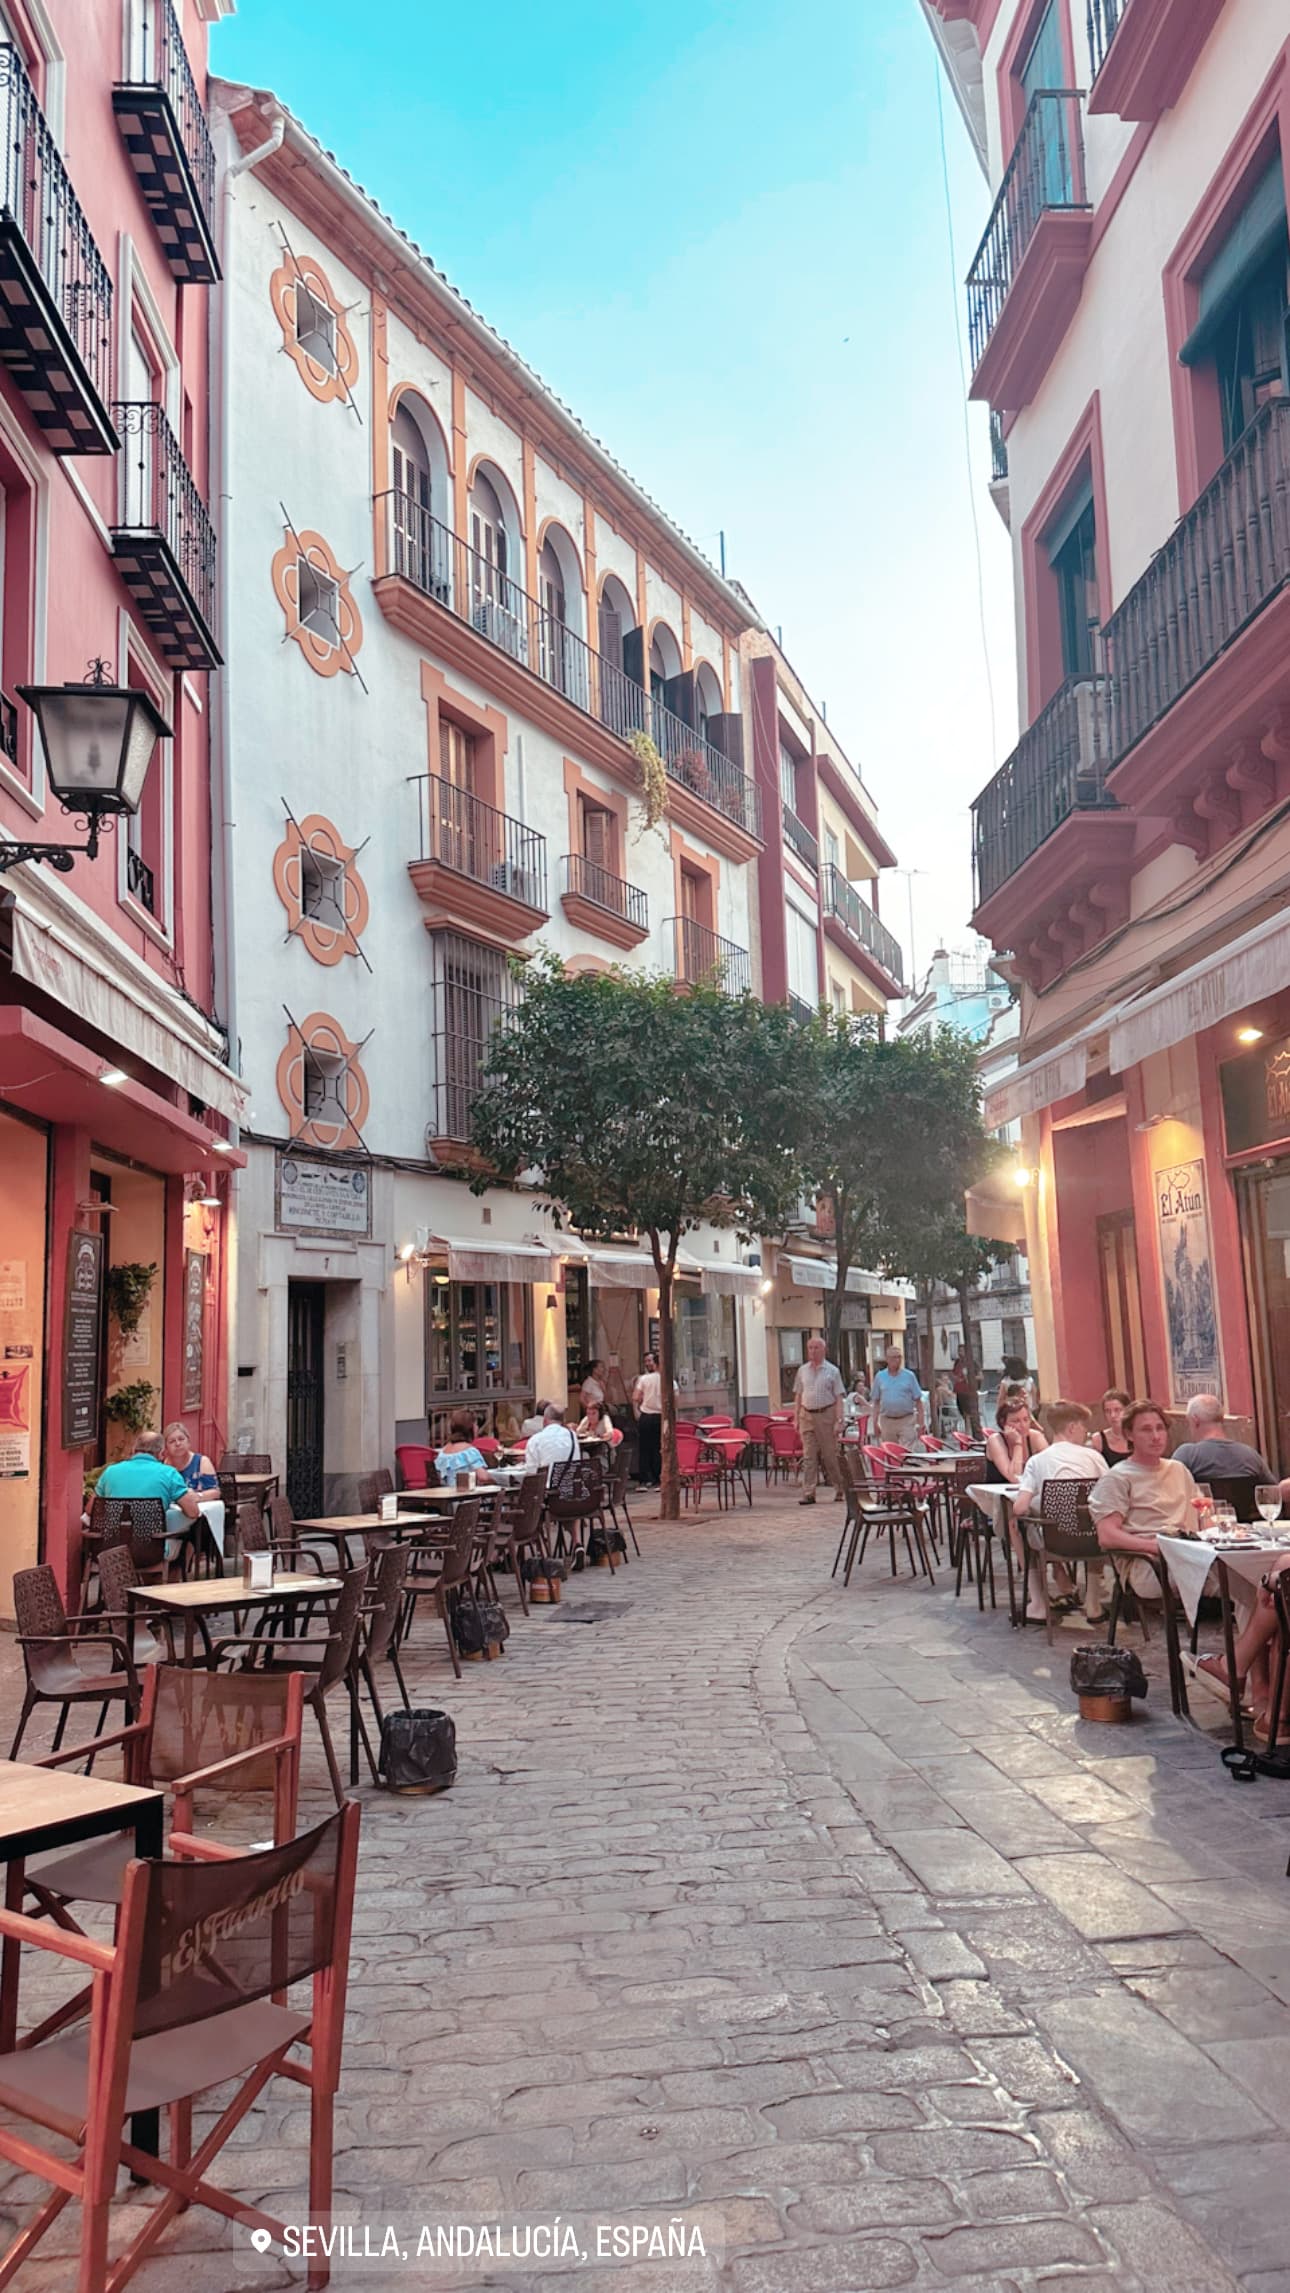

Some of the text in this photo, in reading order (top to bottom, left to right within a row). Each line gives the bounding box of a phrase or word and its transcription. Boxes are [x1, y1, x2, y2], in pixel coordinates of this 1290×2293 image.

[1160, 1188, 1202, 1216] El Atún
[172, 1919, 204, 1974] El
